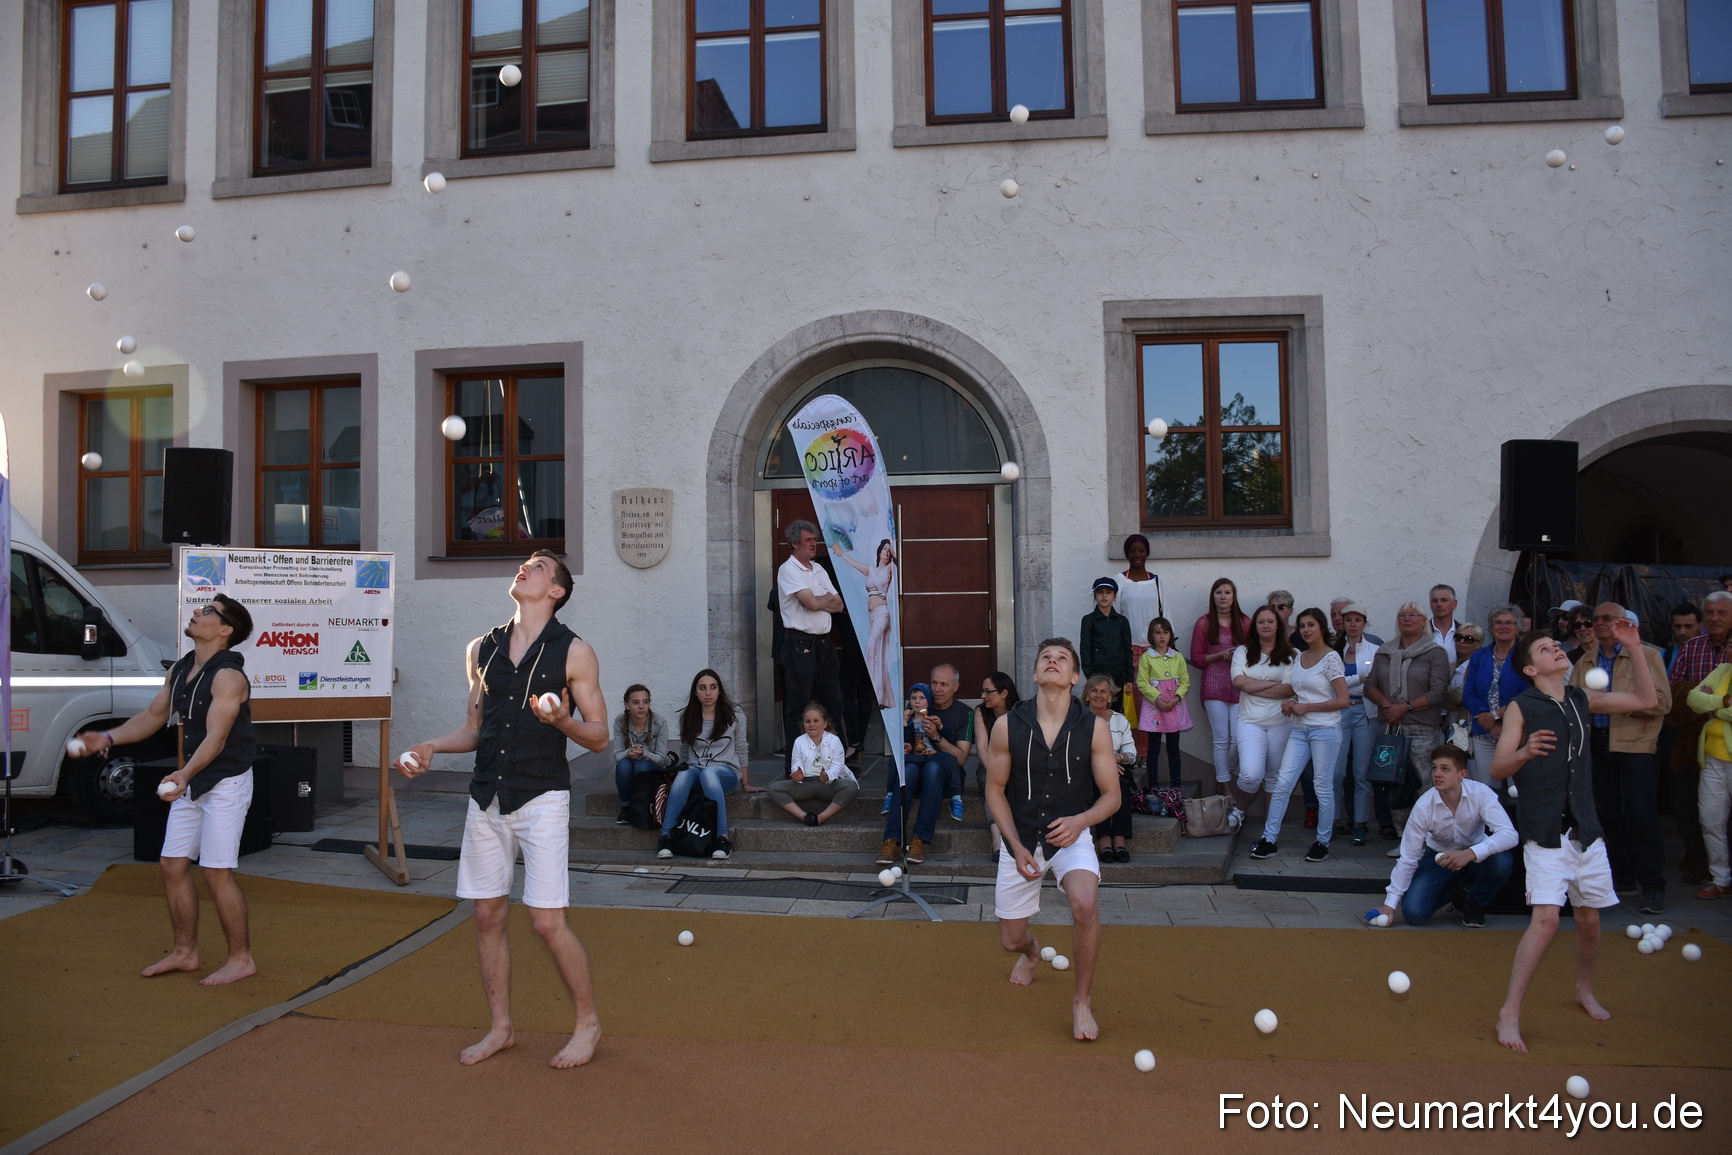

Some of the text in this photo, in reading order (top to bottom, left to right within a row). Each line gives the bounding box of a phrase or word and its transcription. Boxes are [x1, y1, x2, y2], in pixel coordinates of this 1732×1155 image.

[228, 553, 267, 564] Neumarkt
[272, 554, 294, 564] Offen
[295, 555, 309, 565] und
[311, 555, 354, 566] Barrierefrei
[234, 578, 286, 587] Arbeitsgemeinschaft
[309, 597, 333, 605] Arbeit
[328, 618, 380, 627] NEUMARKT
[282, 647, 319, 656] MENSCH
[320, 675, 371, 684] Dienstleistungen
